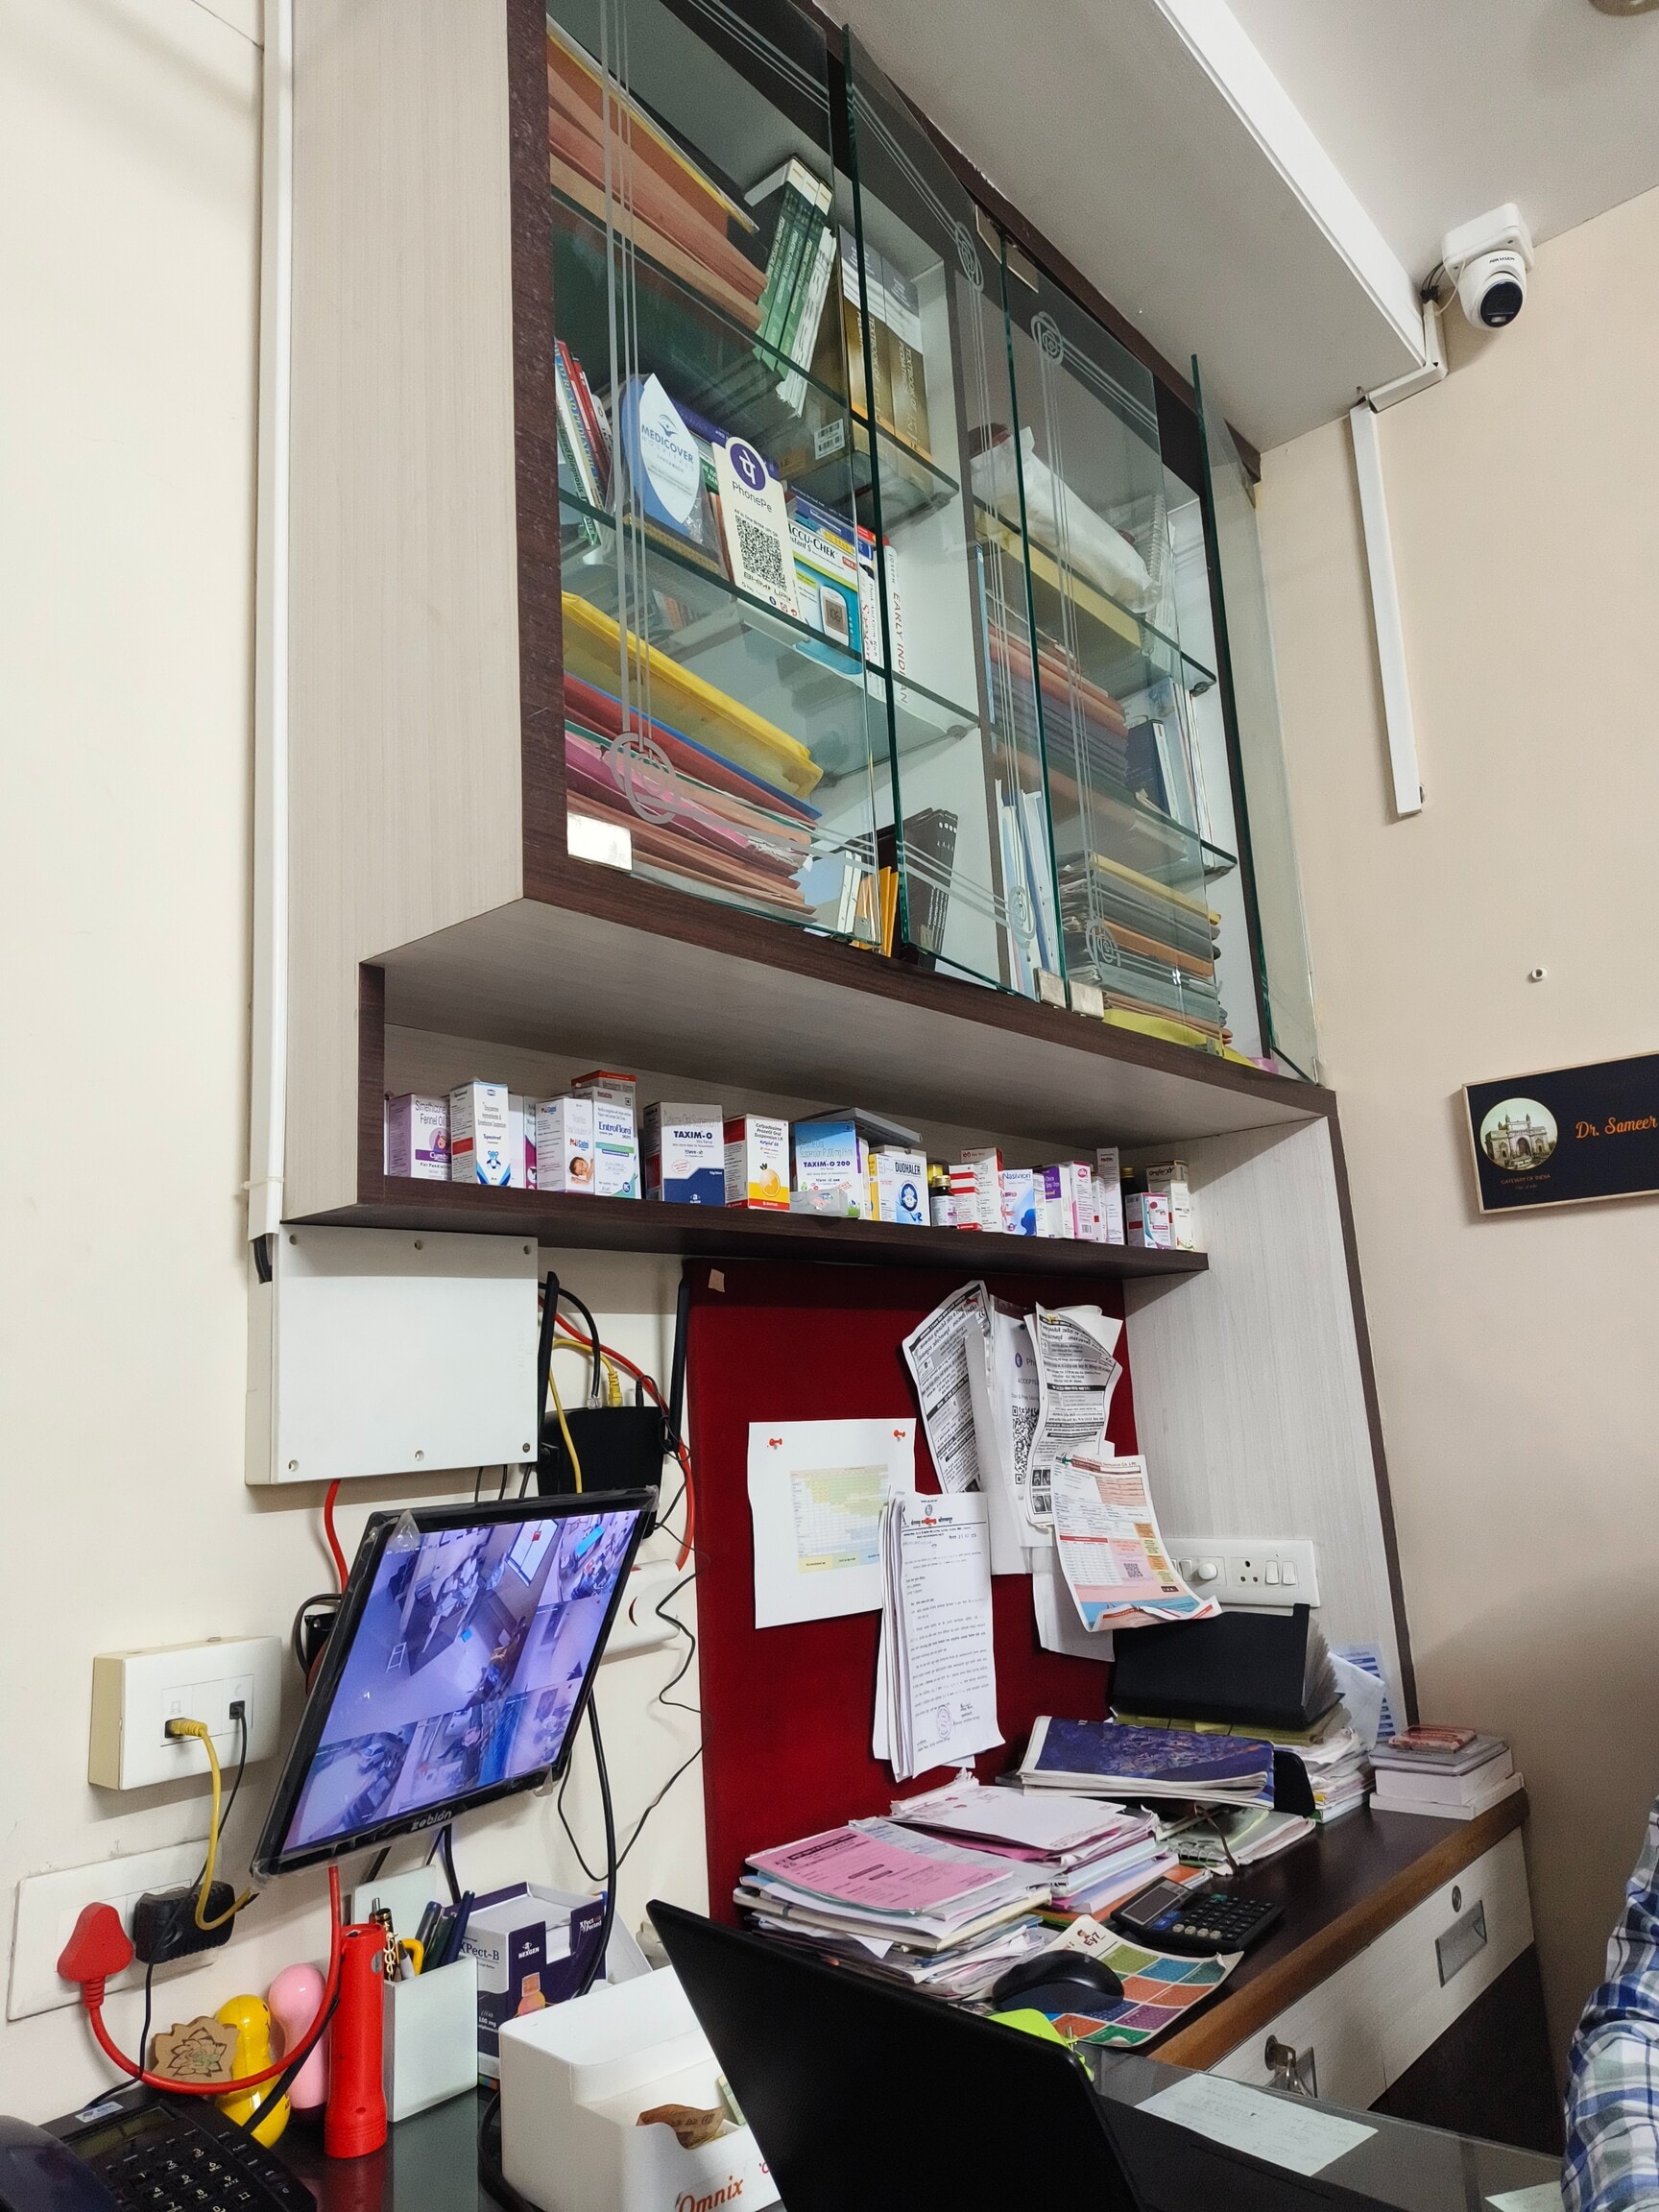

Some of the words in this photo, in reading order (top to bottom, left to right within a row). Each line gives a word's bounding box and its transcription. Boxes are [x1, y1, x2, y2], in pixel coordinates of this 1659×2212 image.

[905, 348, 915, 397] TEXTBOOK
[641, 424, 693, 465] MEDICOVER
[566, 455, 585, 493] Diagnosis
[732, 480, 773, 514] PhonePe
[893, 592, 903, 638] EARLY
[415, 1099, 446, 1115] Simethicone
[420, 1114, 438, 1125] Fennel
[438, 1115, 446, 1126] Oil
[673, 1130, 713, 1140] TAXIM-O
[1575, 1120, 1600, 1140] Dr.
[1604, 1115, 1659, 1135] Sameer
[895, 1161, 922, 1175] DUOHALER
